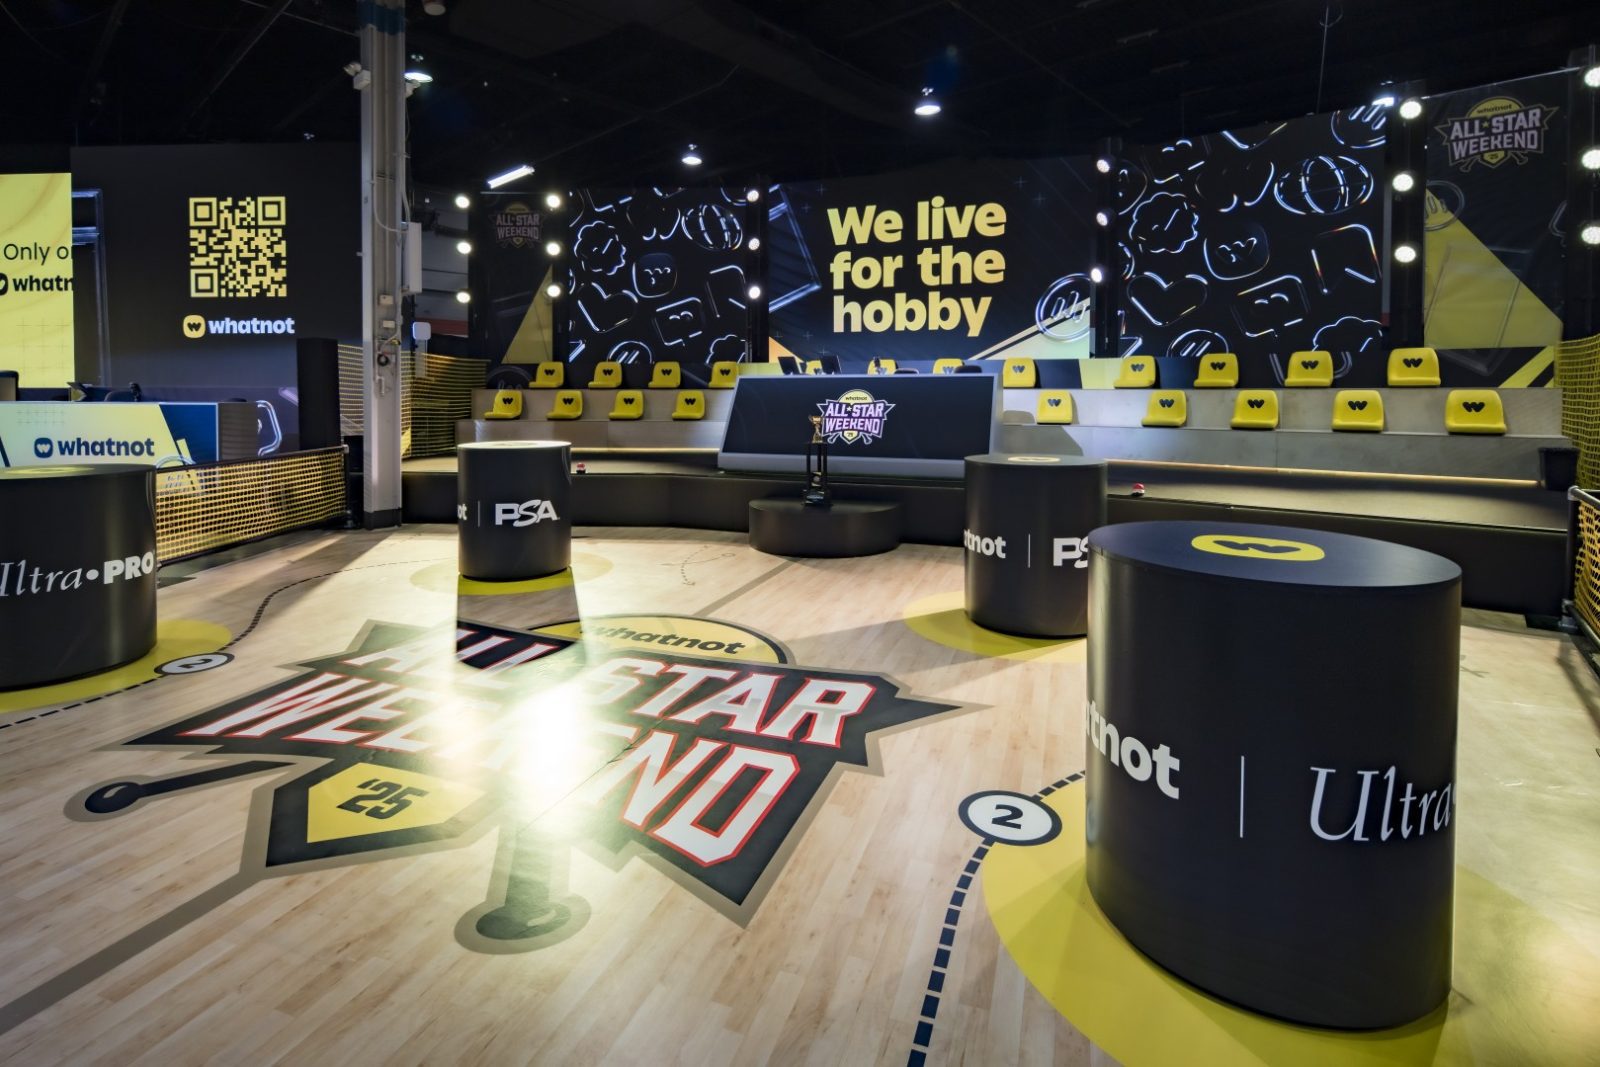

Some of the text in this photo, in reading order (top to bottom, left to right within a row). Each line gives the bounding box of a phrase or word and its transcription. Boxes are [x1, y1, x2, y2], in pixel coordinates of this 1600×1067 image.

[1450, 108, 1541, 139] ALL STAR
[1453, 130, 1538, 160] WEEKEND
[497, 226, 539, 240] WEEKEND
[826, 195, 1007, 246] We live
[3, 242, 51, 266] Only
[829, 245, 1006, 290] for the
[207, 316, 295, 335] whatnot
[832, 291, 993, 338] hobby
[826, 403, 884, 417] ALL STAR
[826, 418, 880, 433] WEEKEND
[57, 437, 155, 458] whatnot
[495, 499, 558, 527] PSA
[177, 658, 213, 669] 2
[578, 656, 877, 748] STAR
[180, 671, 801, 868] WEEND
[1086, 700, 1452, 842] tnot Ultra
[991, 804, 1024, 830] 2
